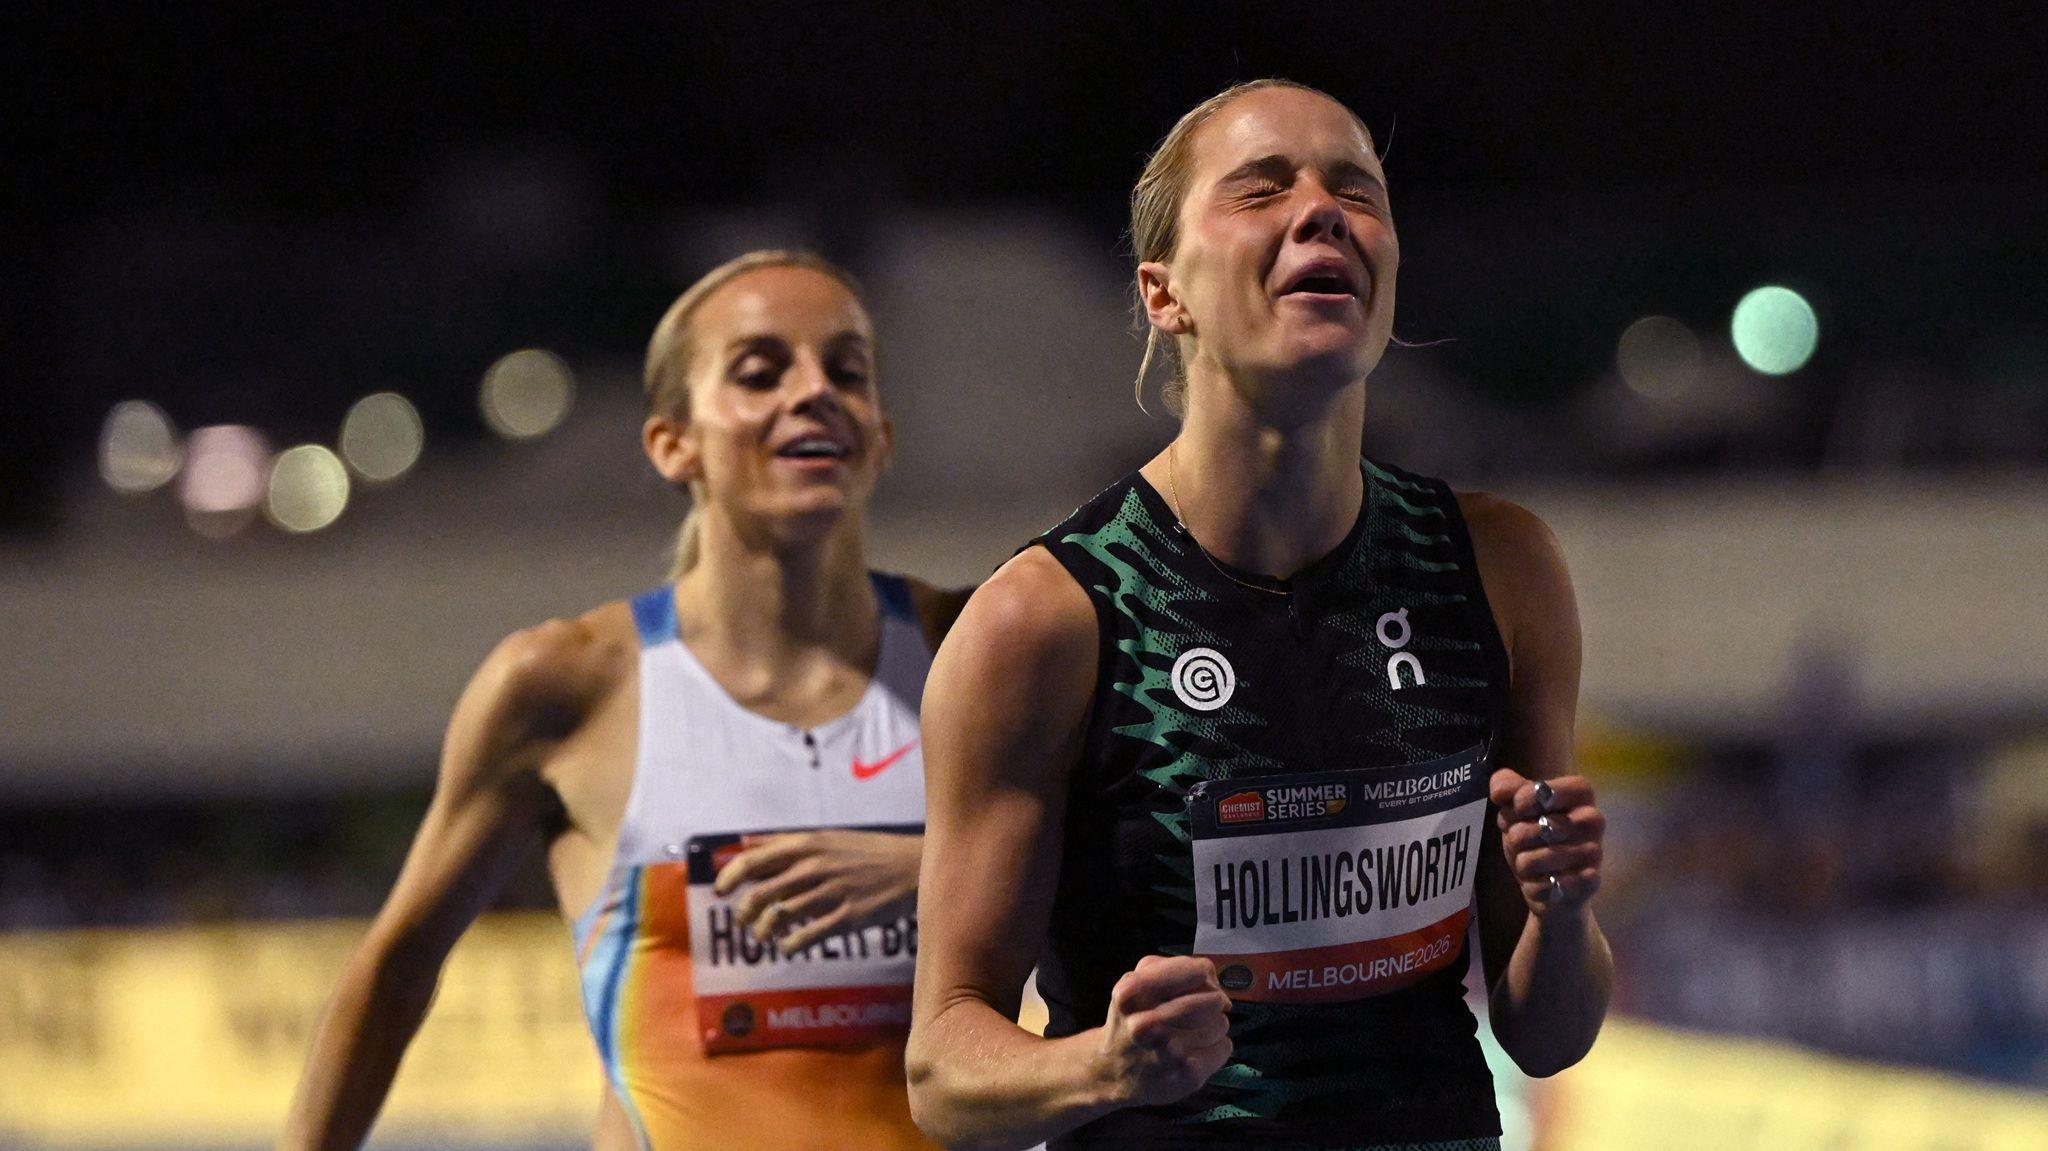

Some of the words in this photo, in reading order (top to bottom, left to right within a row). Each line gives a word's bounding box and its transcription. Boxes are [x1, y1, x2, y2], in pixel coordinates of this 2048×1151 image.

[1364, 763, 1472, 801] MELBOURNE
[1266, 784, 1347, 805] SUMMER
[1379, 798, 1407, 809] EVERY
[1408, 796, 1422, 804] BIT
[1422, 786, 1462, 801] DIFFERENT
[1222, 801, 1261, 814] CHEMIST
[1267, 801, 1326, 820] SERIES
[1213, 825, 1471, 930] HOLLINGSWORTH
